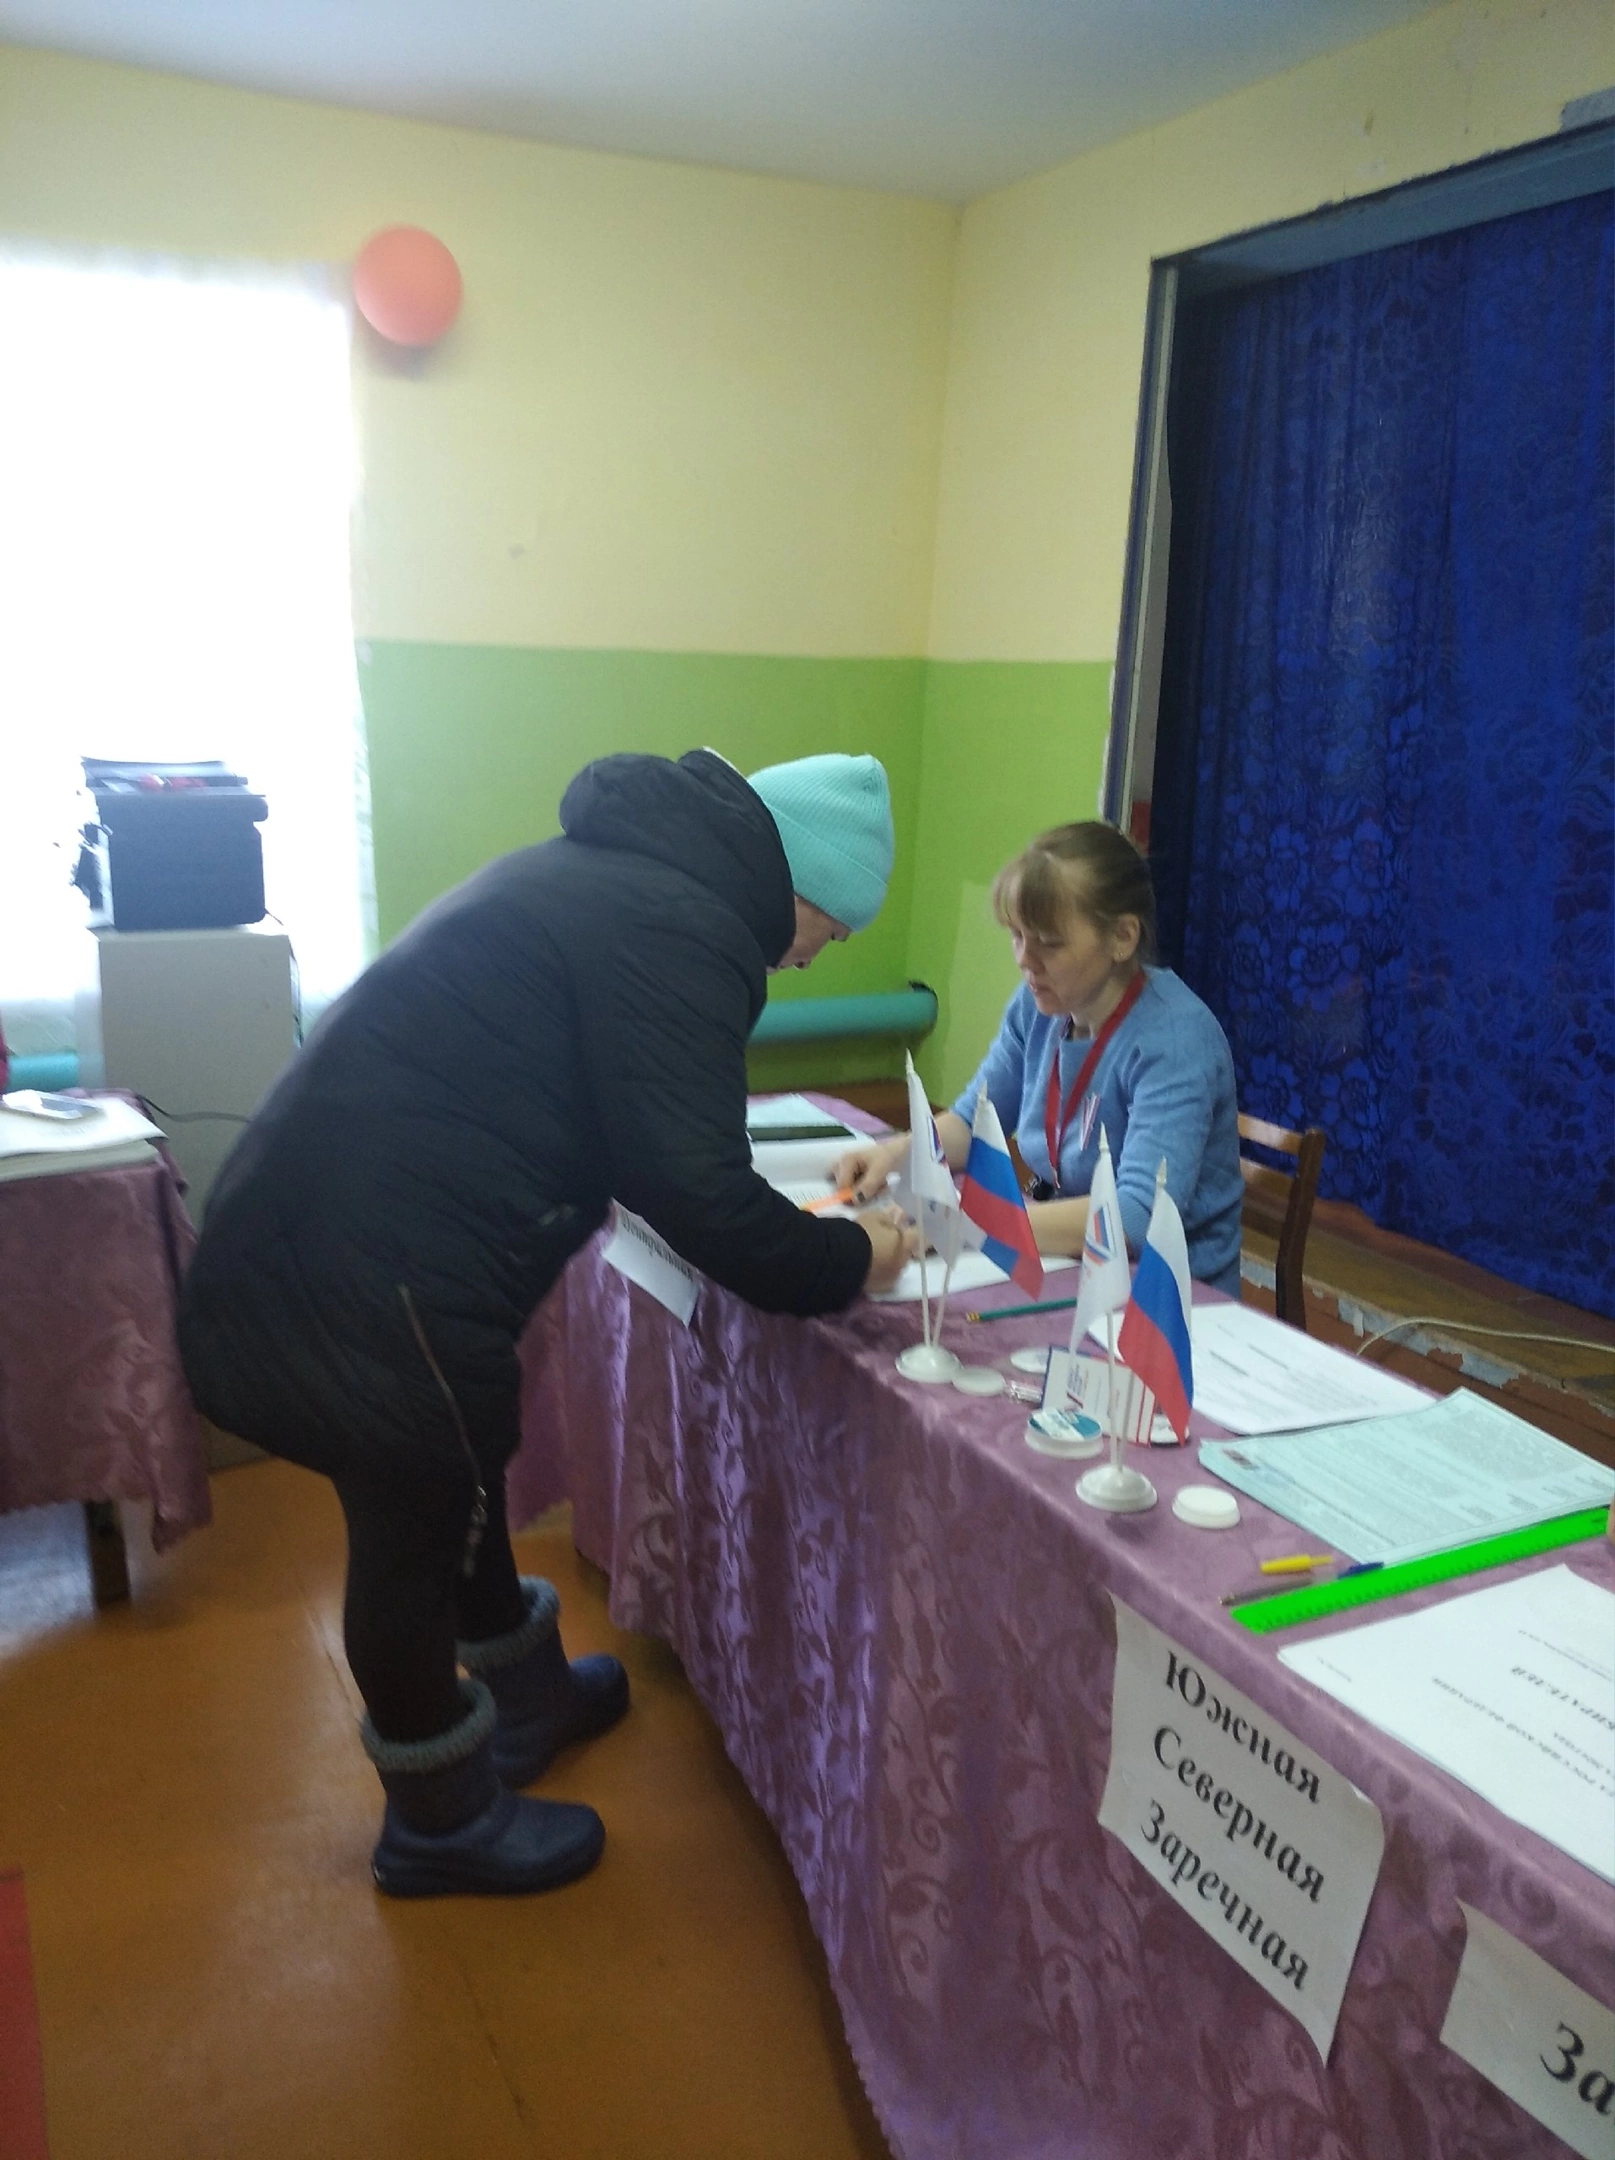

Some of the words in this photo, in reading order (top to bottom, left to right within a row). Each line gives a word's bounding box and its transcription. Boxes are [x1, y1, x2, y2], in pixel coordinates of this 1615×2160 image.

[1154, 1725, 1325, 1903] Северная
[1165, 1650, 1320, 1804] Южная
[1140, 1799, 1309, 1992] Заречная
